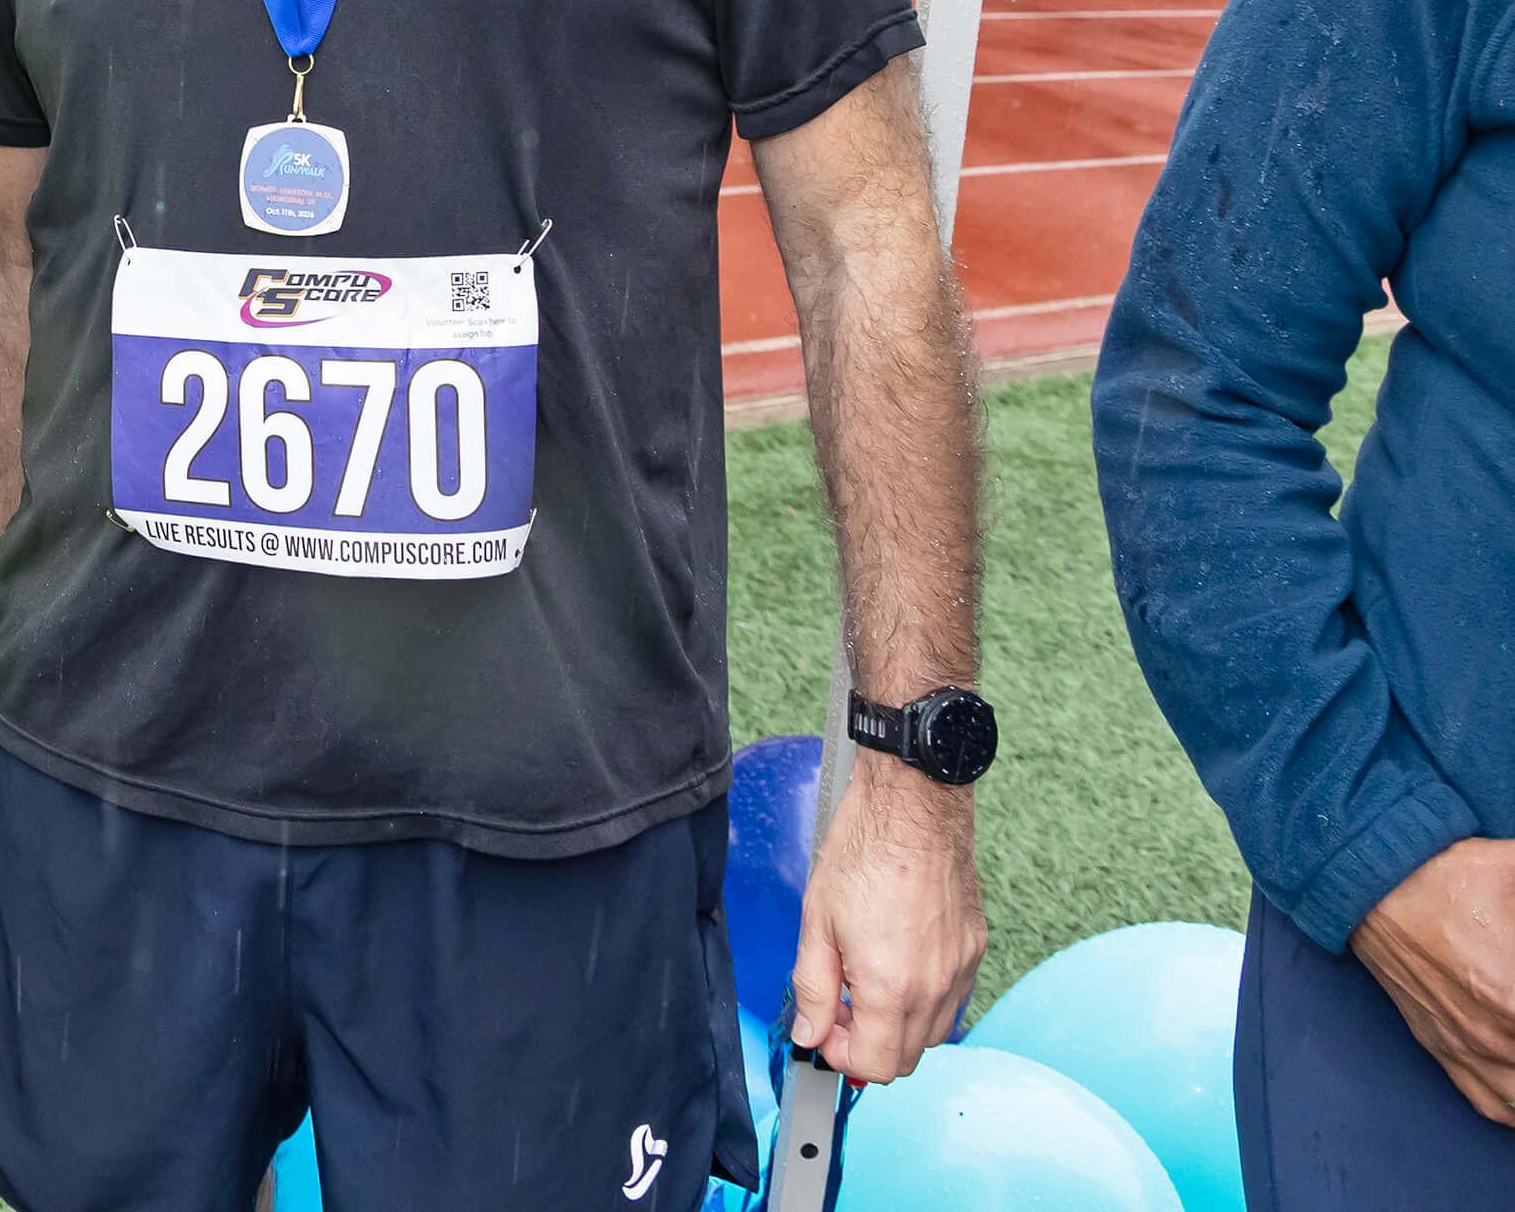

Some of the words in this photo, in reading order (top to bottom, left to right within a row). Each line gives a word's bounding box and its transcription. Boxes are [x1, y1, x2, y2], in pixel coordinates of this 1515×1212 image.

[160, 349, 486, 521] 2670
[146, 520, 181, 543] LIVE
[185, 524, 256, 553] RESULTS
[260, 532, 280, 557] @
[284, 535, 508, 566] WWW.COMPUSCORE.COM
